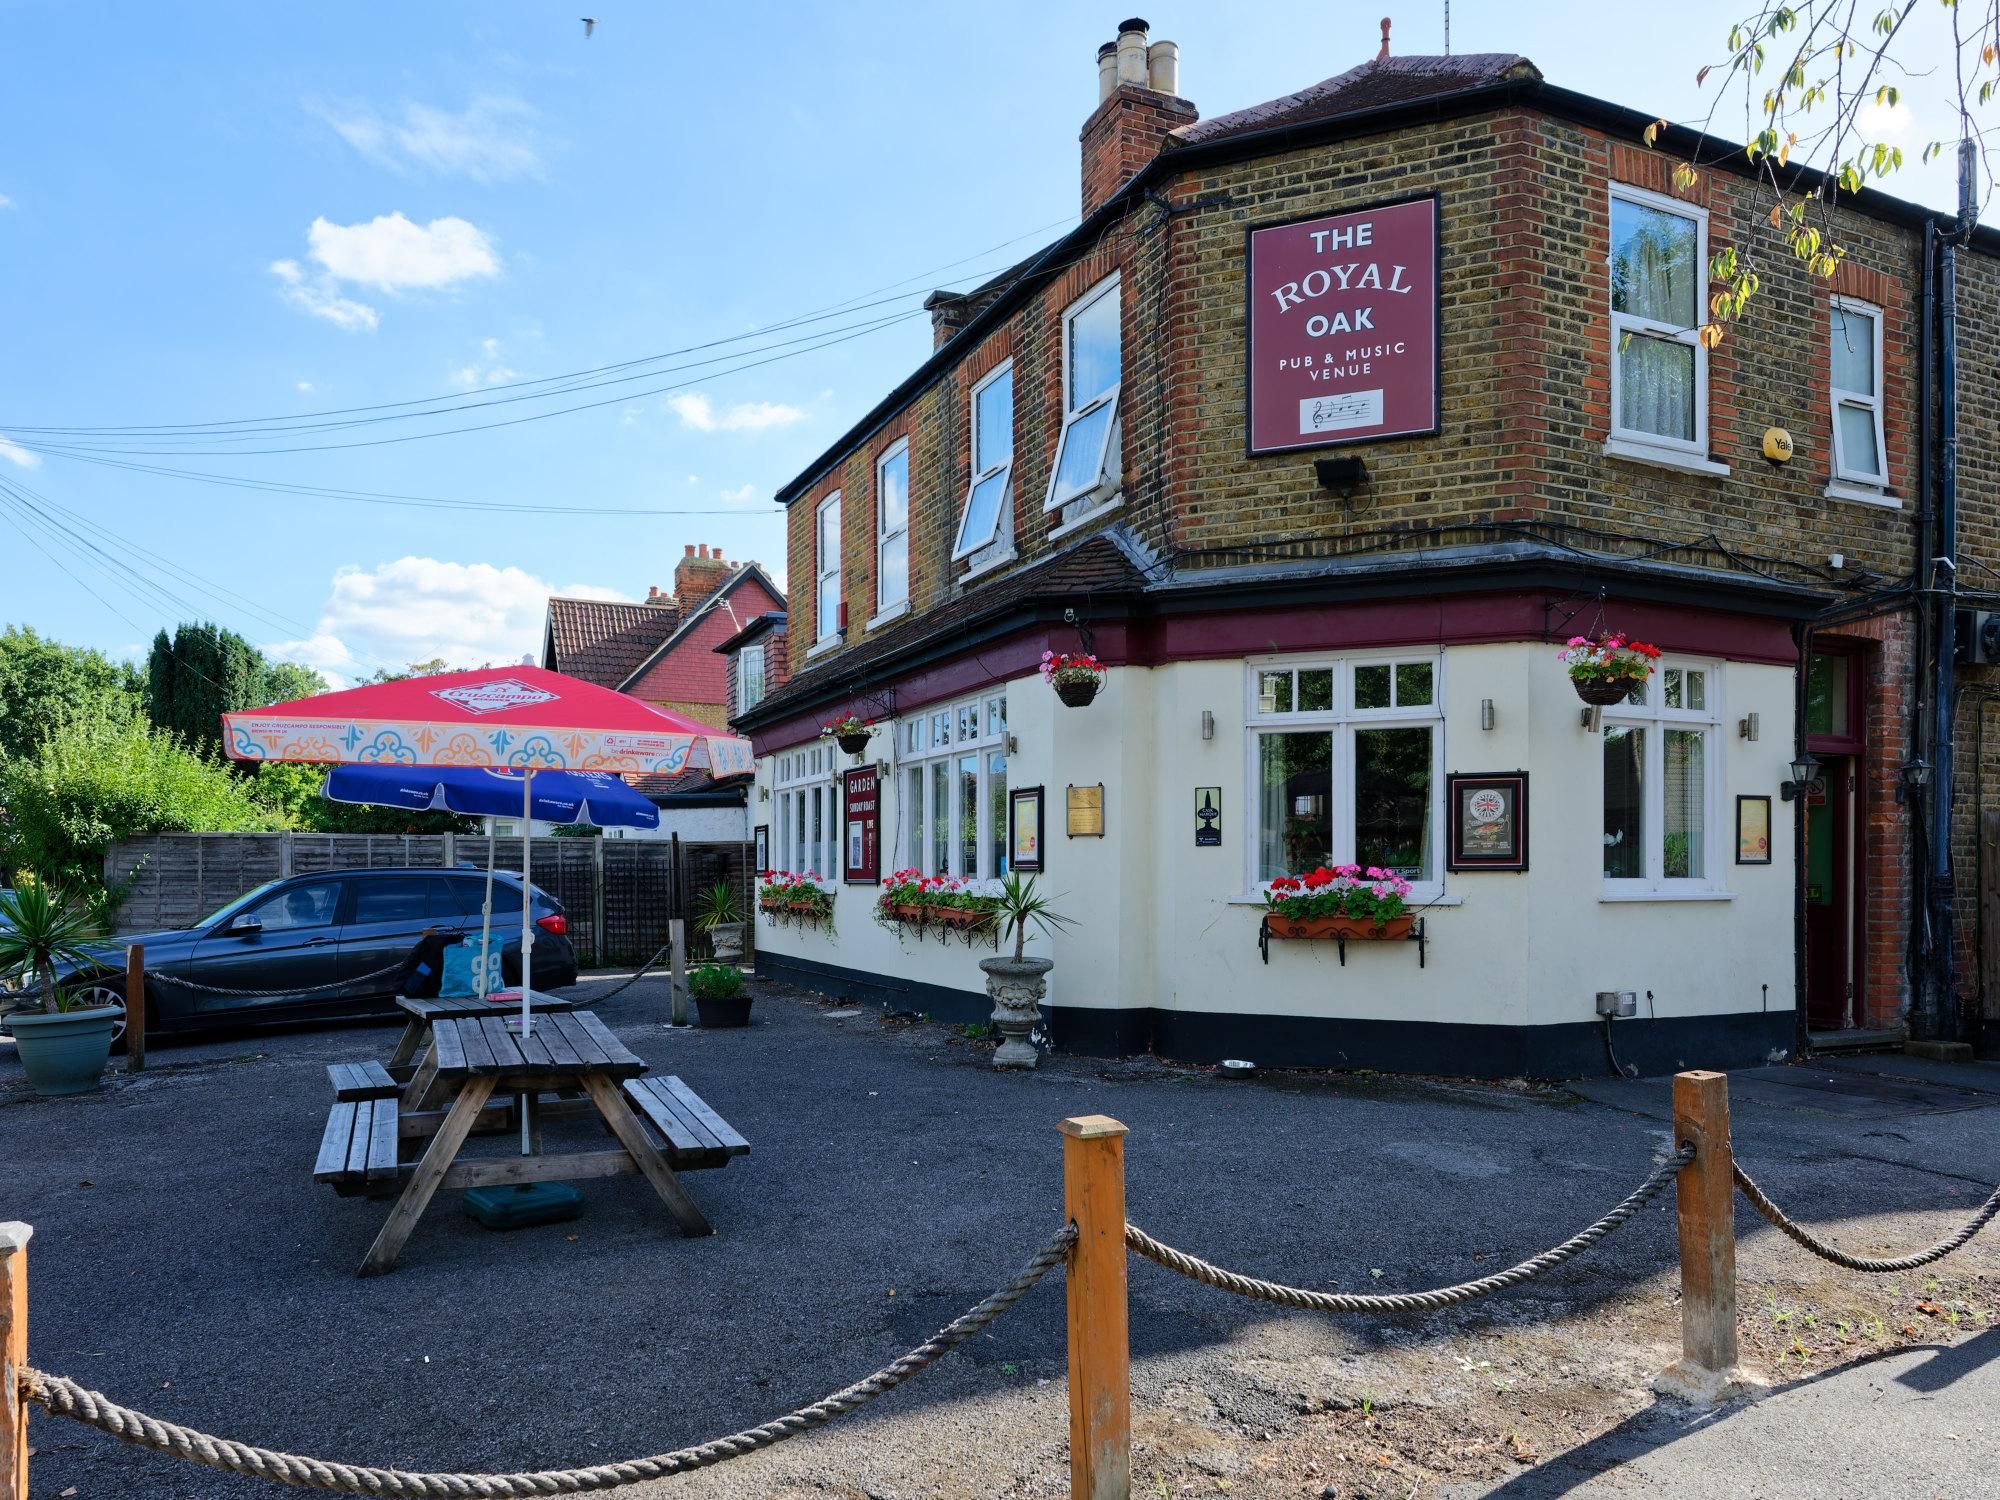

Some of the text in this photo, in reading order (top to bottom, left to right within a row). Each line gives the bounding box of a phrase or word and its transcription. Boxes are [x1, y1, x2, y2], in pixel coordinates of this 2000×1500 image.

[1310, 223, 1373, 253] THE
[1271, 263, 1413, 313] ROYAL
[1306, 307, 1375, 337] OAK
[1279, 342, 1405, 370] PUB & MUSIC
[1310, 363, 1371, 381] VENUE
[1775, 438, 1792, 451] Yale
[850, 777, 875, 793] GARDEN
[849, 800, 875, 813] SUNDAY ROAST
